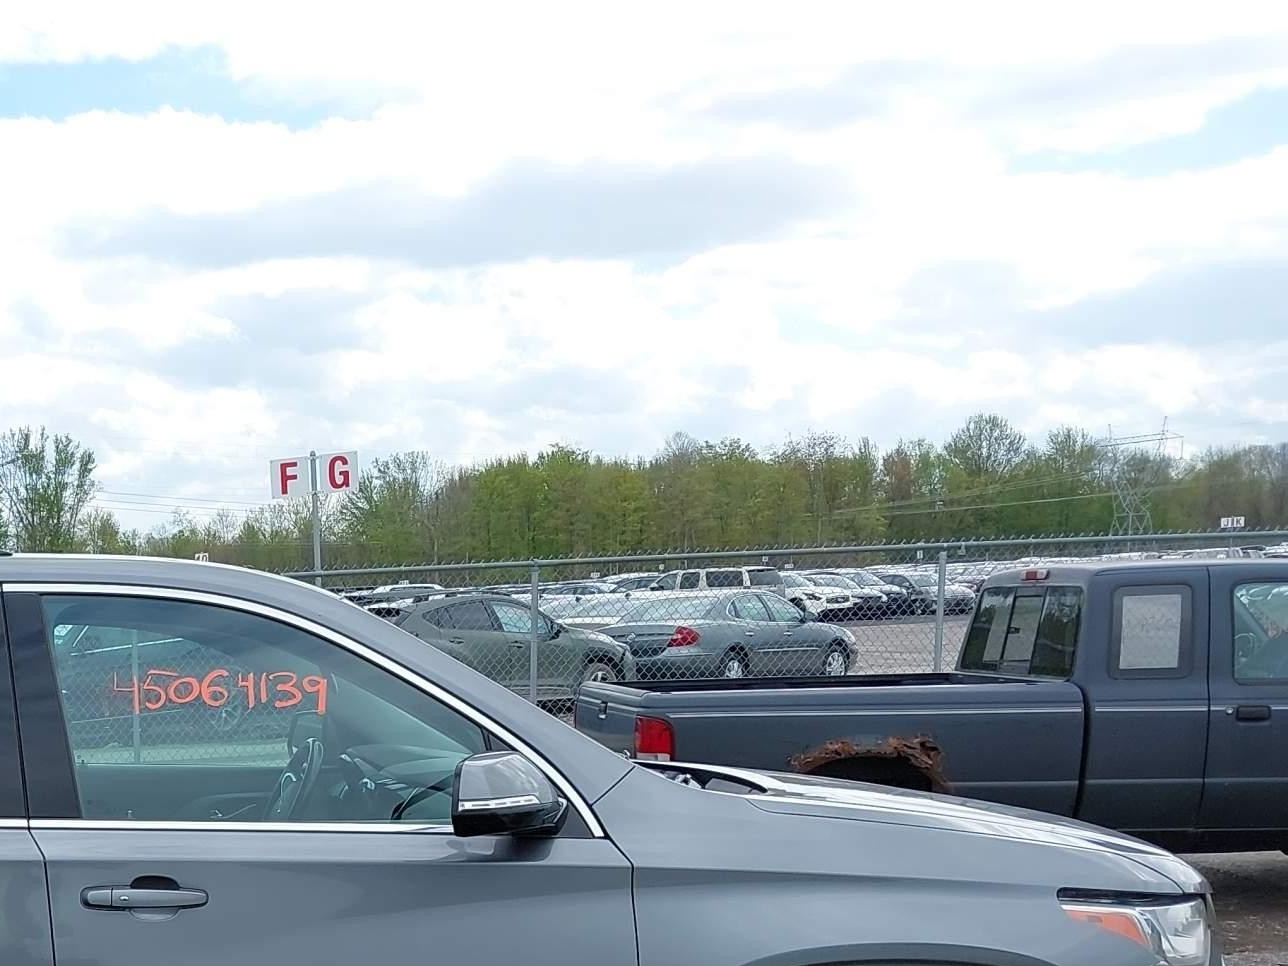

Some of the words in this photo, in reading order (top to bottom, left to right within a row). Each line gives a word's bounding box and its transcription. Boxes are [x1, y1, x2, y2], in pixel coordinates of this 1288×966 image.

[280, 462, 297, 495] F
[329, 456, 350, 489] G
[113, 669, 328, 715] 45064139
